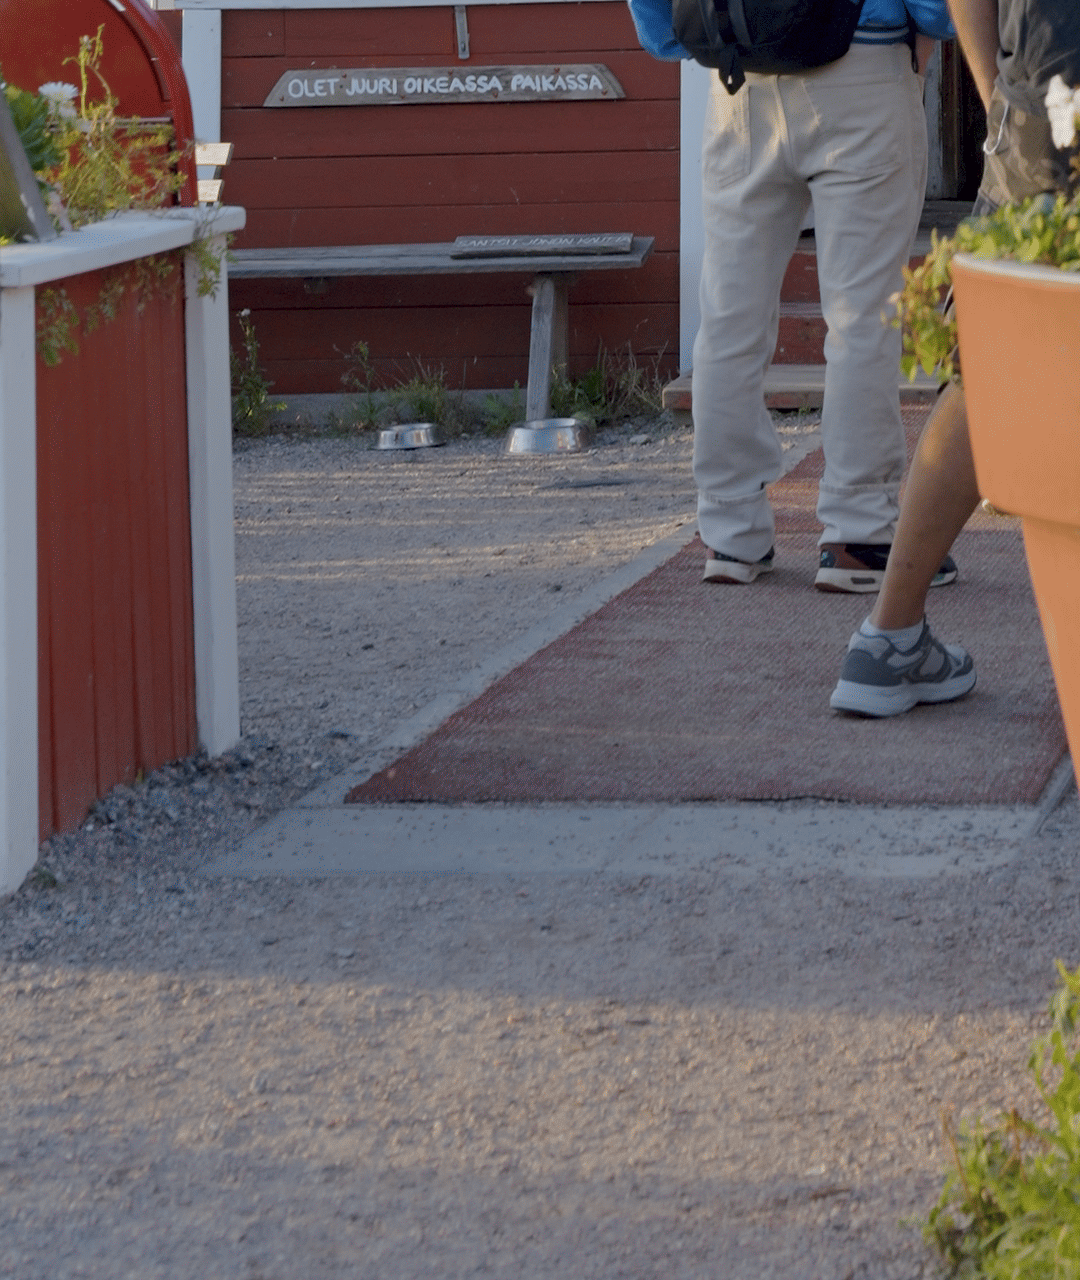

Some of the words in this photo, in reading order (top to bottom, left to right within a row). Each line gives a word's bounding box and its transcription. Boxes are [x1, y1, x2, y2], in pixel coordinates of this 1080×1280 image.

[288, 78, 340, 98] OLET
[345, 77, 398, 96] JUURI
[403, 76, 503, 95] OIKEASSA
[510, 74, 603, 92] PAIKASSA
